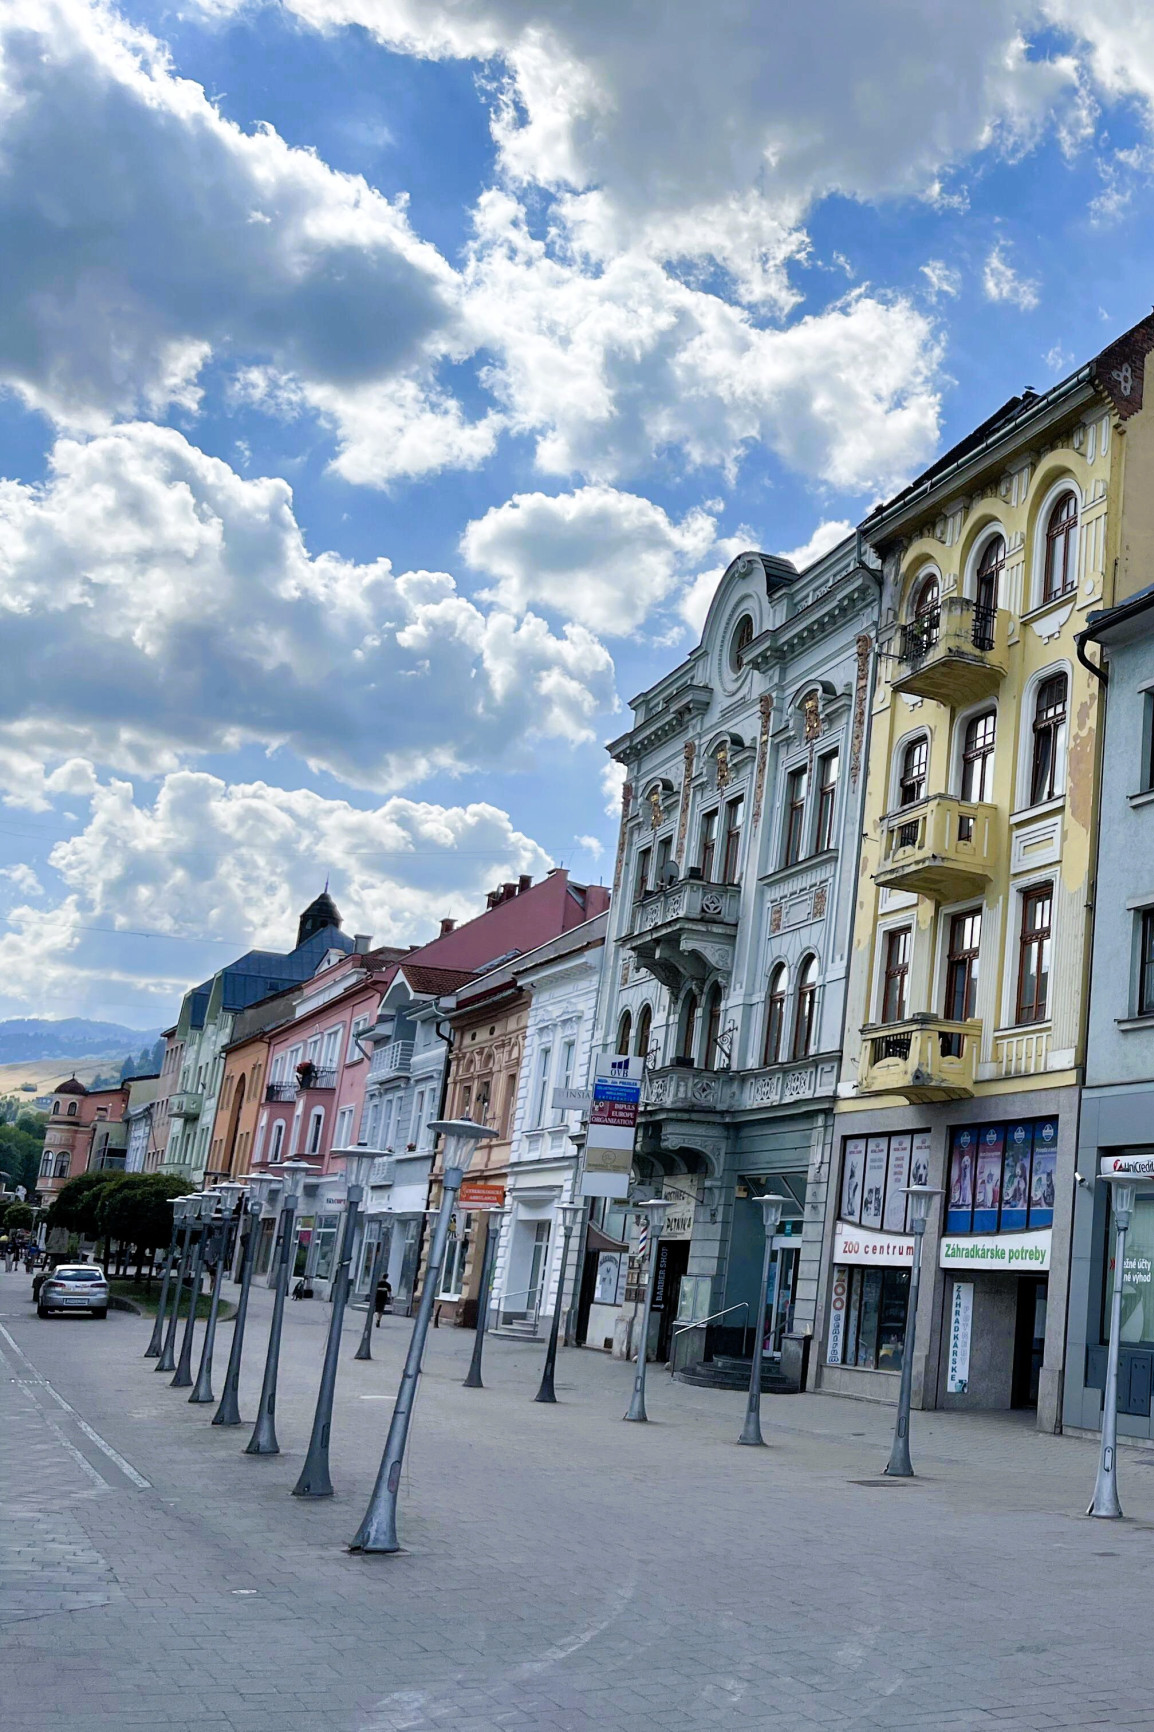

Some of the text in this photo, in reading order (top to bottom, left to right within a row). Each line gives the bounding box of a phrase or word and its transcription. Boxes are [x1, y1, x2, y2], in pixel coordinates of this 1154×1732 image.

[610, 1069, 629, 1077] OVB
[591, 1116, 634, 1126] ORGANIZATION
[1124, 1160, 1154, 1173] UniCredit
[843, 1241, 914, 1256] ZOO centrum
[945, 1243, 1047, 1265] Záhradkárske potreby
[1137, 1258, 1152, 1271] účty
[656, 1246, 669, 1302] BARBER SHOP
[1132, 1271, 1151, 1284] výhod
[833, 1269, 846, 1311] ZOO
